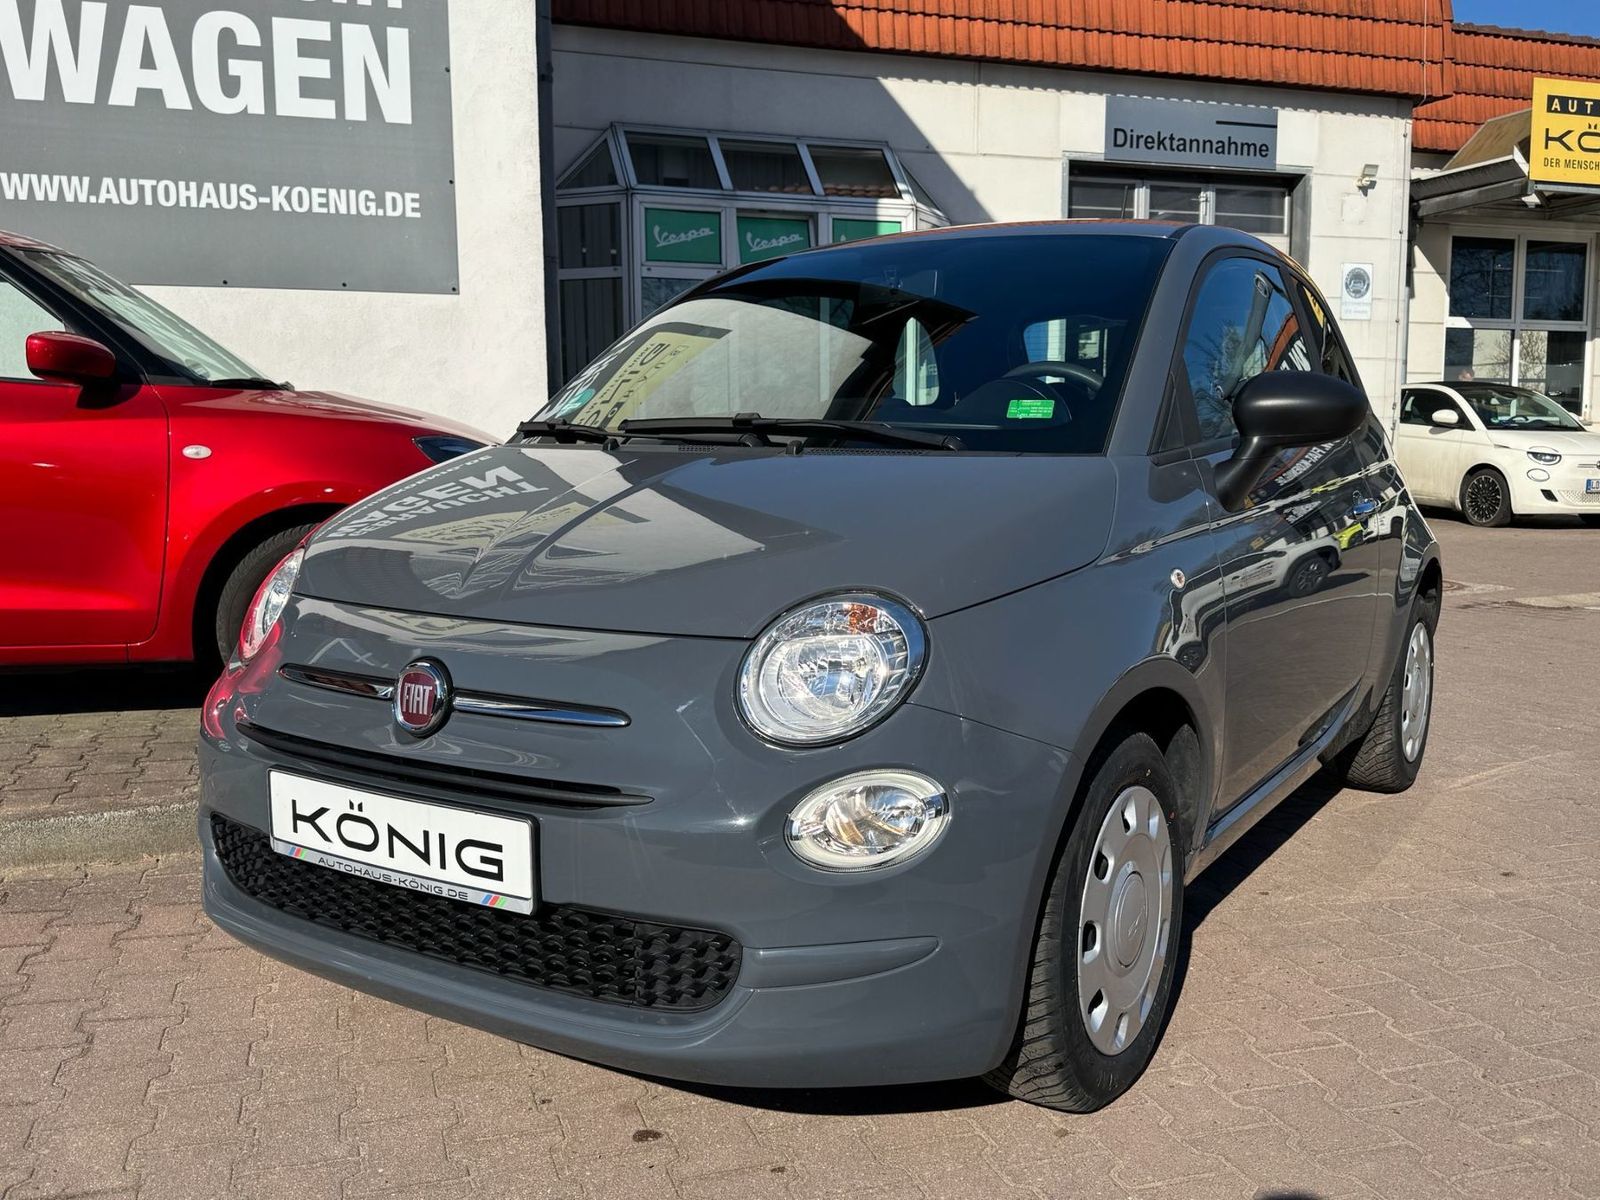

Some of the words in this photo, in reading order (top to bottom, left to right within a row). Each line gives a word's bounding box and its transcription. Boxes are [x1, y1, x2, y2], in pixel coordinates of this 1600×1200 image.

[0, 0, 413, 125] WAGEN
[1113, 127, 1270, 158] Direktannahme
[1543, 157, 1561, 169] DER
[1564, 158, 1600, 171] MENSCH
[0, 172, 422, 219] WWW.AUTOHAUS-KOENIG.DE
[653, 224, 715, 248] Vespa
[746, 231, 804, 252] Vespa
[402, 681, 433, 716] FIAT
[291, 798, 504, 883] KÖNIG
